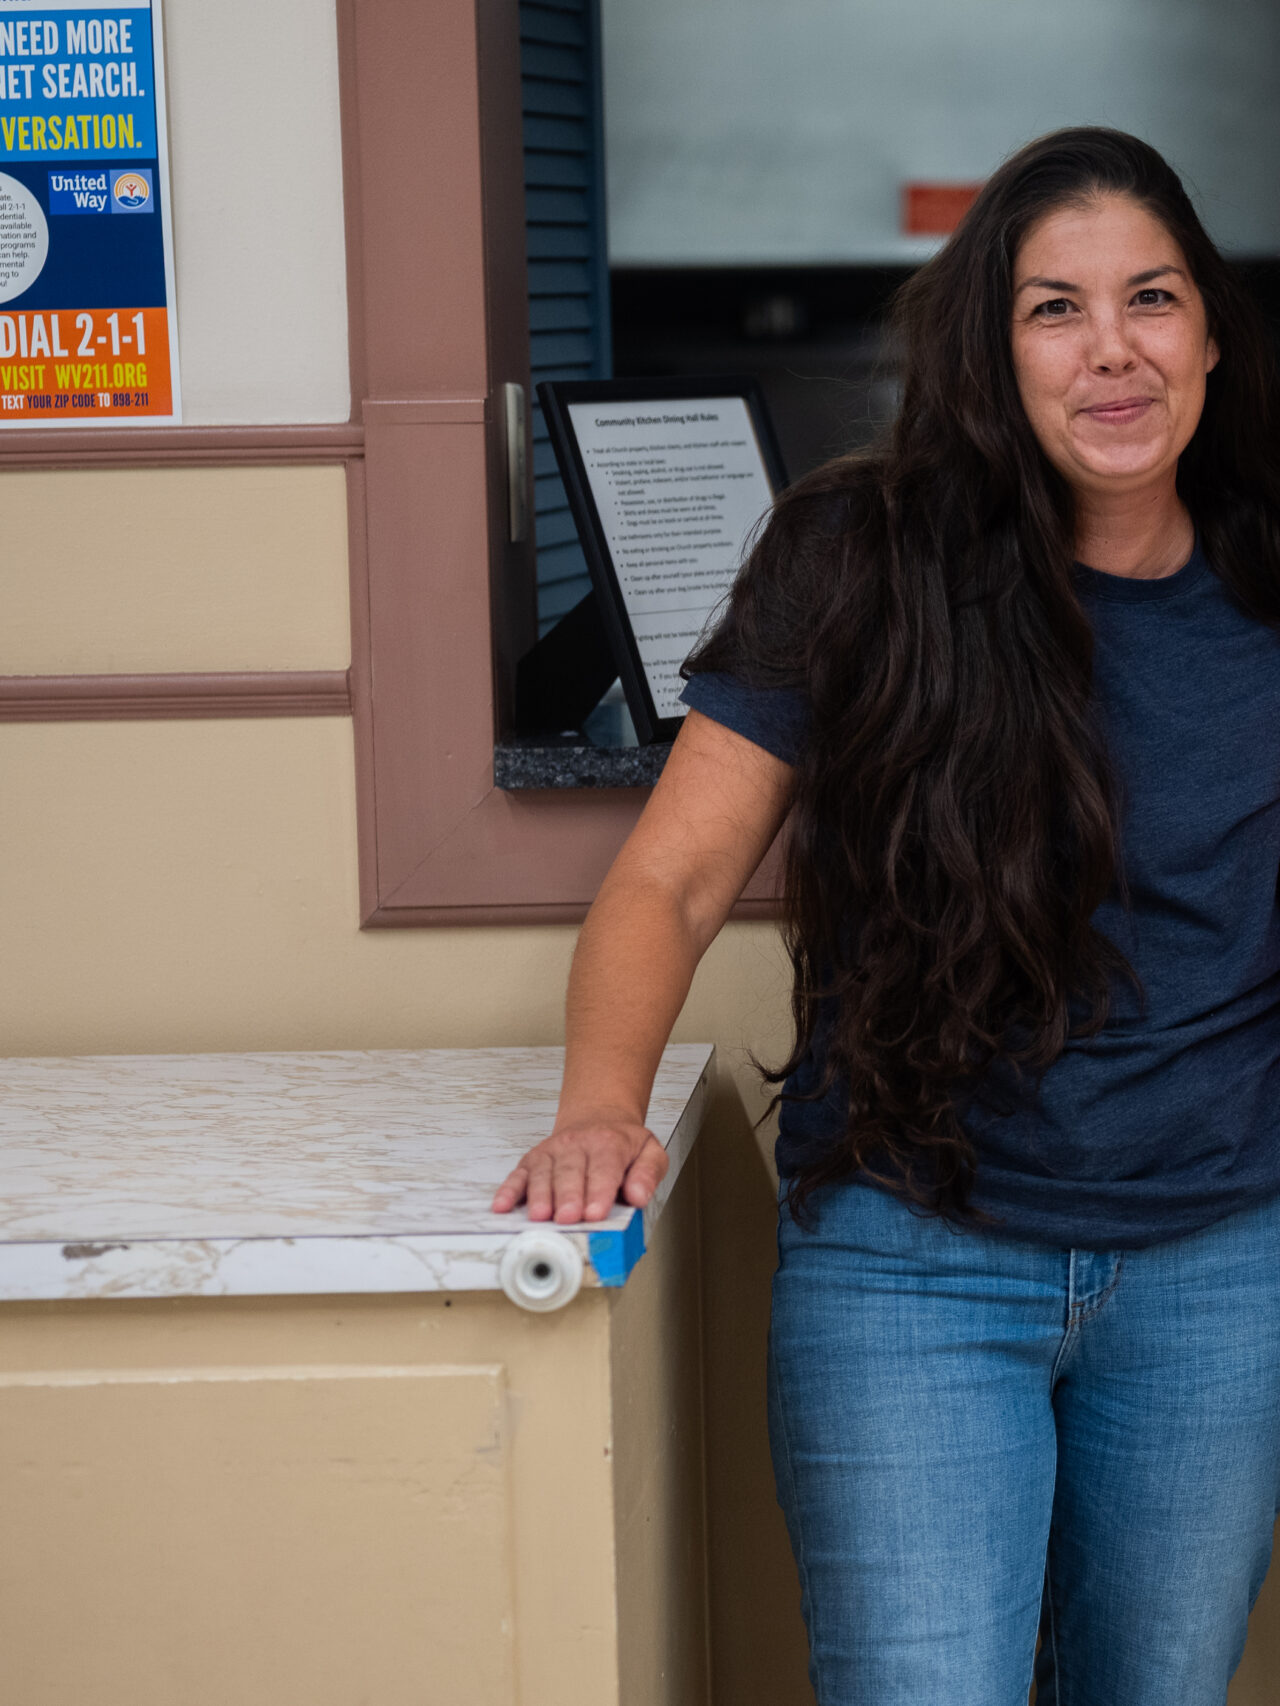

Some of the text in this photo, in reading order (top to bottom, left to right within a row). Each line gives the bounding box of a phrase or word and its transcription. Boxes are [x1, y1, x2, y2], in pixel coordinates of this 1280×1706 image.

[0, 19, 133, 56] NEED MORE
[42, 62, 145, 99] SEARCH.
[1, 114, 142, 151] VERSATION.
[51, 174, 107, 192] United
[9, 202, 26, 210] 2-1-1
[73, 192, 107, 211] Way
[1, 221, 32, 230] available
[23, 231, 37, 240] and
[1, 241, 36, 251] programs
[12, 250, 30, 261] help.
[12, 269, 19, 278] to
[0, 311, 146, 359] DIAL 2-1-1
[0, 362, 148, 391] VISIT WV211.ORG
[1, 392, 149, 410] TEXT YOUR ZIP CODE TO 898-211
[594, 412, 718, 428] Community Kitchen Dining Hall Rules
